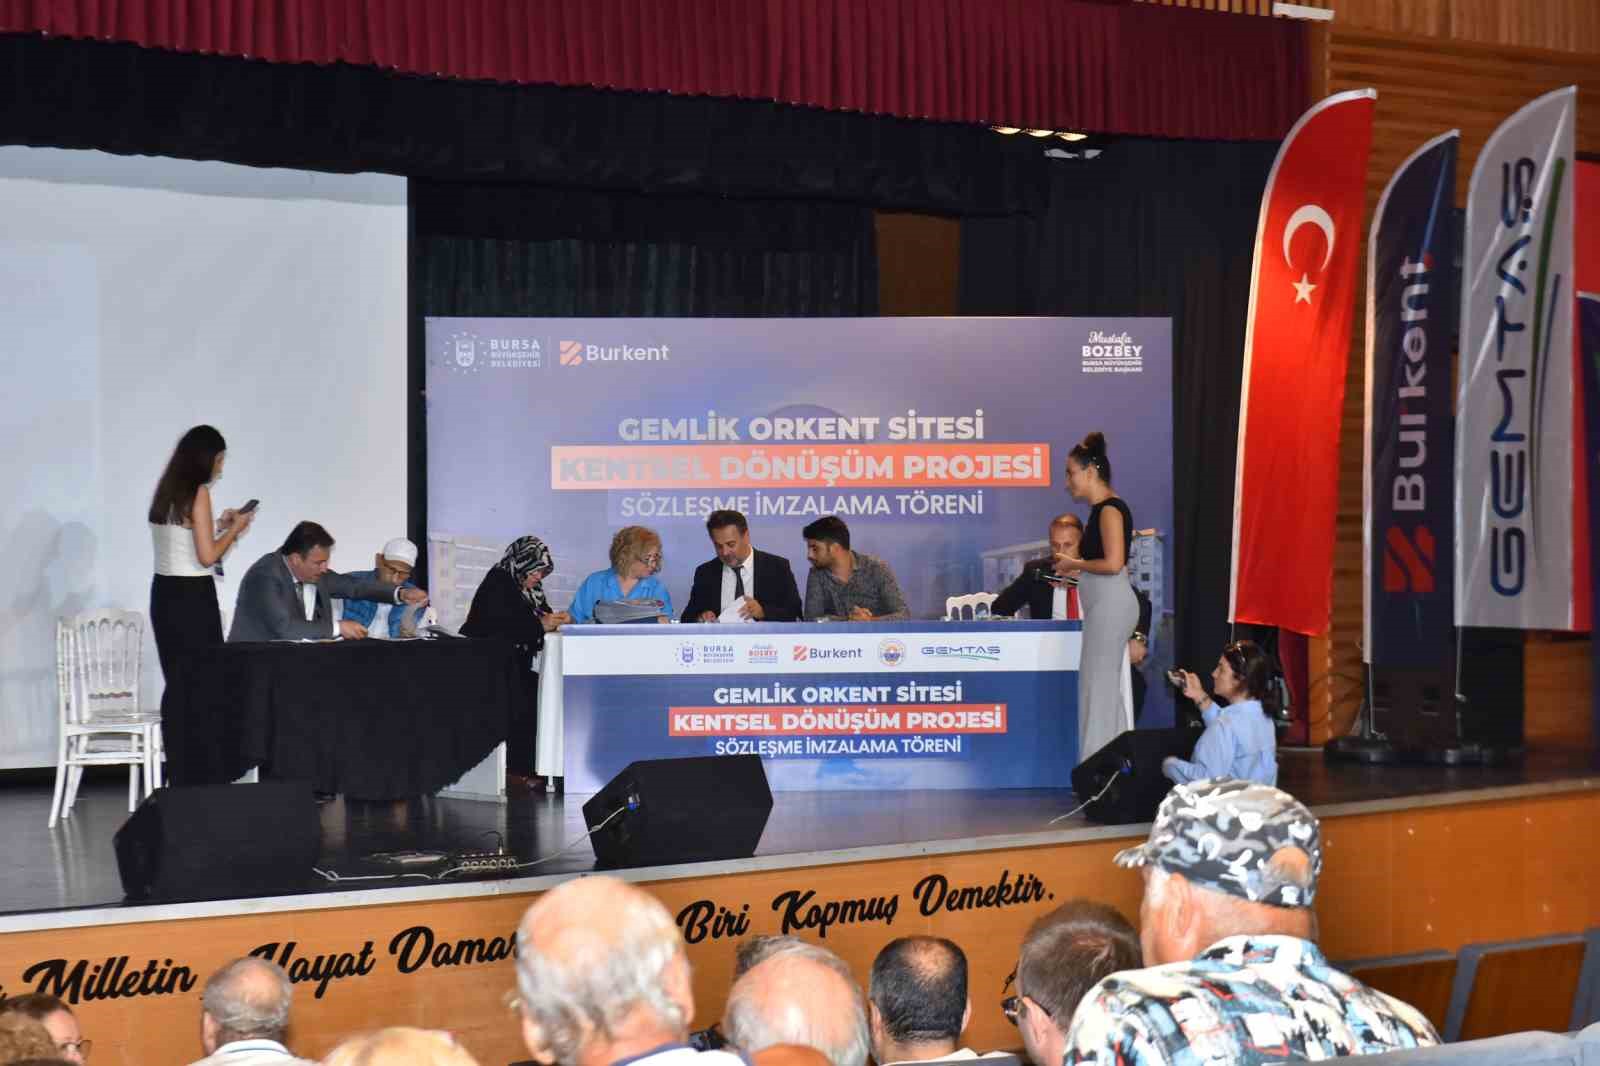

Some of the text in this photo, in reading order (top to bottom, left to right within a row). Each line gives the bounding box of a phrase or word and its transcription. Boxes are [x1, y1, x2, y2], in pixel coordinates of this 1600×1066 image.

[490, 339, 540, 350] BURSA
[586, 343, 670, 362] Burkent
[1082, 345, 1142, 357] BOZBEY
[1392, 253, 1428, 512] Burkent
[618, 409, 984, 442] GEMLİK ORKENT SİTESİ
[560, 446, 1043, 486] KENTSEL DÖNÜŞÜM PROJESİ
[755, 490, 891, 516] İMZALAMA
[896, 489, 984, 515] TÖRENİ
[810, 646, 863, 660] Burkent
[713, 680, 963, 705] GEMLİK ORKENT SİTESİ
[674, 705, 1003, 734] KENTSEL DÖNÜŞÜM PROJESİ
[715, 734, 962, 757] SÖZLEŞME İMZALAMA TÖRENİ
[22, 955, 198, 1004] Milletin
[678, 899, 750, 945] Biri
[772, 889, 899, 939] Kopmuş
[912, 868, 1055, 917] Demektir.
